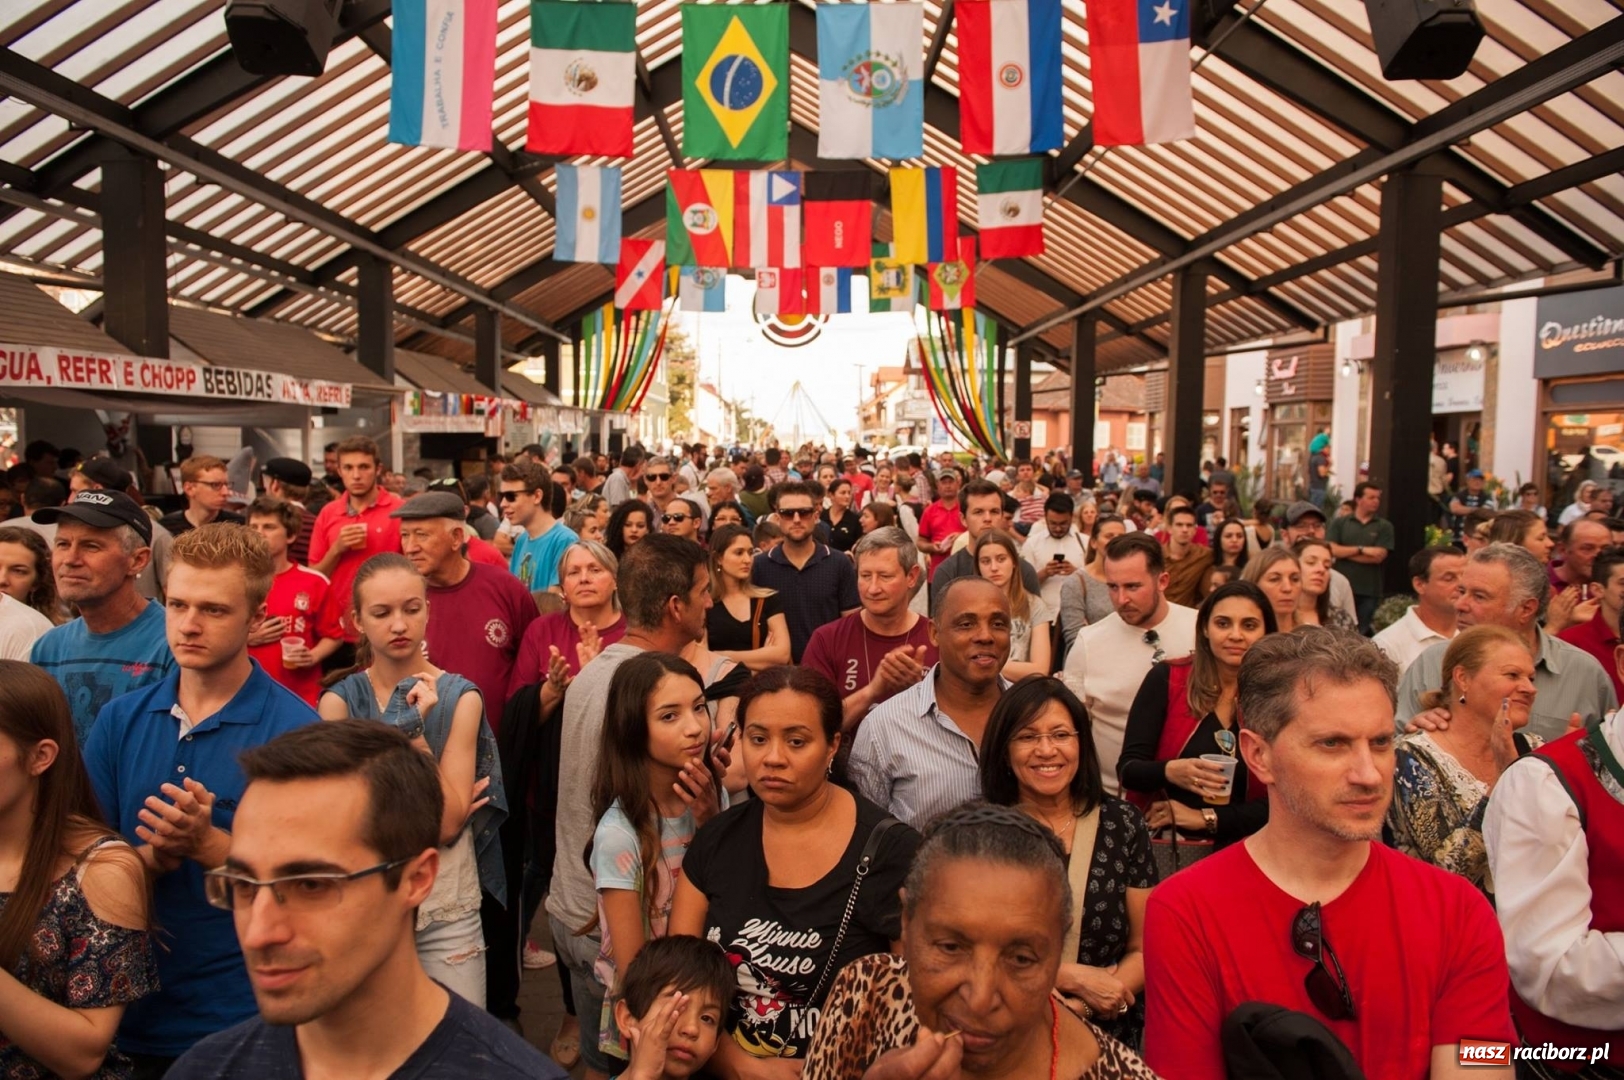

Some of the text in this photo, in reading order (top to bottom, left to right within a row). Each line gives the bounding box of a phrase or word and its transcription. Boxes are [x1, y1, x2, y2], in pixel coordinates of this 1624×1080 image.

[57, 354, 116, 385] REFR
[140, 363, 196, 391] CHOPP
[202, 367, 273, 399] BEBIDAS
[738, 918, 822, 949] Minnie
[729, 938, 816, 975] Mouse
